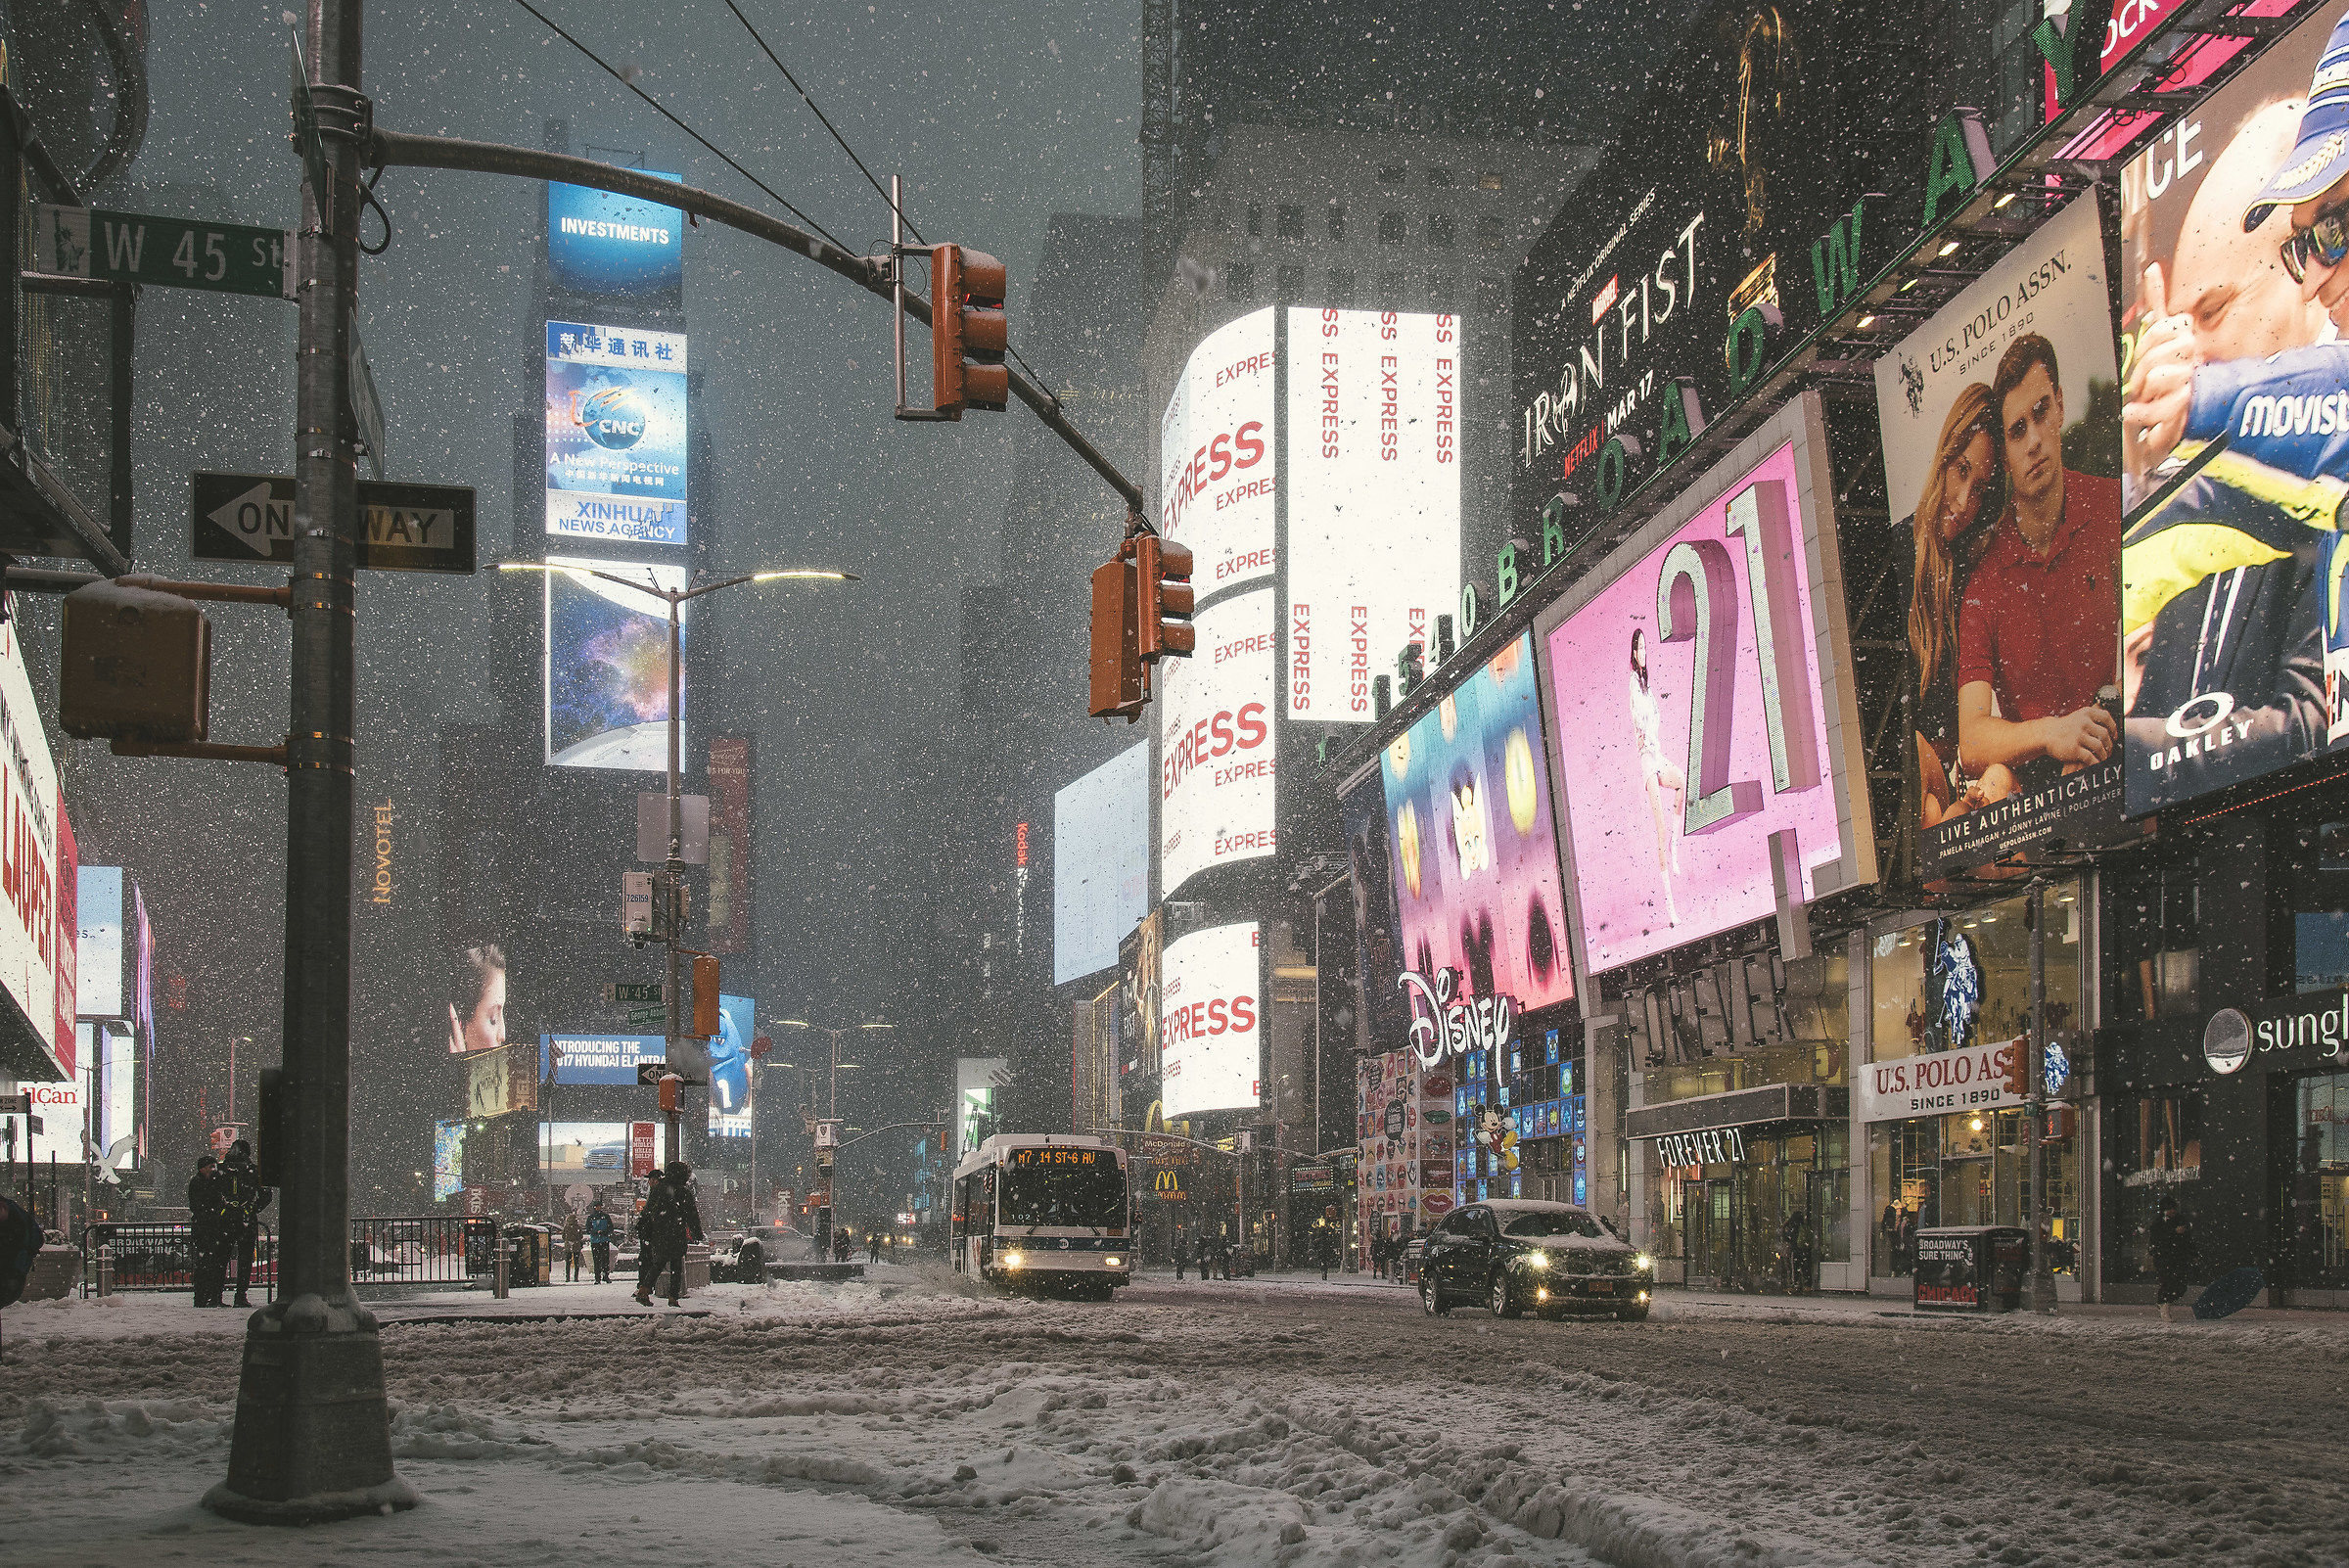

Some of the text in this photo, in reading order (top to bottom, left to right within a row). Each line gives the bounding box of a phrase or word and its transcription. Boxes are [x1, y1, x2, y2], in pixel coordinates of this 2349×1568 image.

[105, 221, 146, 273] W
[172, 230, 226, 281] 45
[561, 216, 669, 245] INVESTMENTS
[1567, 262, 1594, 303] NETFLIX
[1594, 222, 1629, 269] ORIGINAL
[1629, 186, 1656, 227] SERIES
[1497, 0, 2087, 609] BROADWAY
[1617, 209, 1705, 368] FIST
[1929, 249, 2072, 374] U.S. POLO ASSN.
[1960, 311, 2034, 376] SINCE 1890
[598, 418, 642, 437] CNC
[1321, 352, 1339, 459] EXPRESS
[1380, 355, 1398, 462] EXPRESS
[1436, 358, 1453, 464] EXPRESS
[1606, 368, 1654, 436] MAR 17
[549, 451, 680, 476] A New Perspective
[1163, 421, 1266, 540] EXPRESS
[1564, 428, 1598, 481] NETFLIX
[237, 501, 291, 535] ON
[357, 510, 438, 544] WAY
[559, 518, 676, 540] NEWS AGENCY
[1294, 604, 1310, 710] EXPRESS
[1351, 606, 1367, 712] EXPRESS
[1656, 480, 1821, 838] 21
[1164, 702, 1267, 801] EXPRESS
[2149, 717, 2254, 771] OAKLEY
[1939, 844, 1963, 858] PAMELA
[1964, 831, 2000, 851] FLANAGAN
[2069, 799, 2090, 813] POLO
[2092, 787, 2122, 805] PLAYER
[1940, 763, 2122, 845] LIVE AUTHENTICALLY
[374, 798, 392, 903] NOVOTEL
[1017, 823, 1028, 867] Kodak
[626, 894, 649, 902] 726159
[619, 986, 628, 998] W
[635, 987, 648, 999] 45
[1623, 945, 1797, 1072] FOREVER
[555, 1040, 640, 1054] NTRODUCING THE
[1163, 994, 1257, 1050] EXPRESS
[2257, 992, 2349, 1057] sungl
[557, 1055, 574, 1067] 017
[576, 1056, 619, 1068] HYUNDAI
[1876, 1049, 2010, 1094] U.S. POLO AS
[1911, 1088, 2000, 1110] SINCE 1890
[1040, 1152, 1050, 1163] 14
[1082, 1152, 1095, 1163] AV
[1656, 1128, 1745, 1169] FOREVER 21
[1919, 1239, 1968, 1250] BROADWAY'S
[1919, 1250, 1964, 1261] SURE THING
